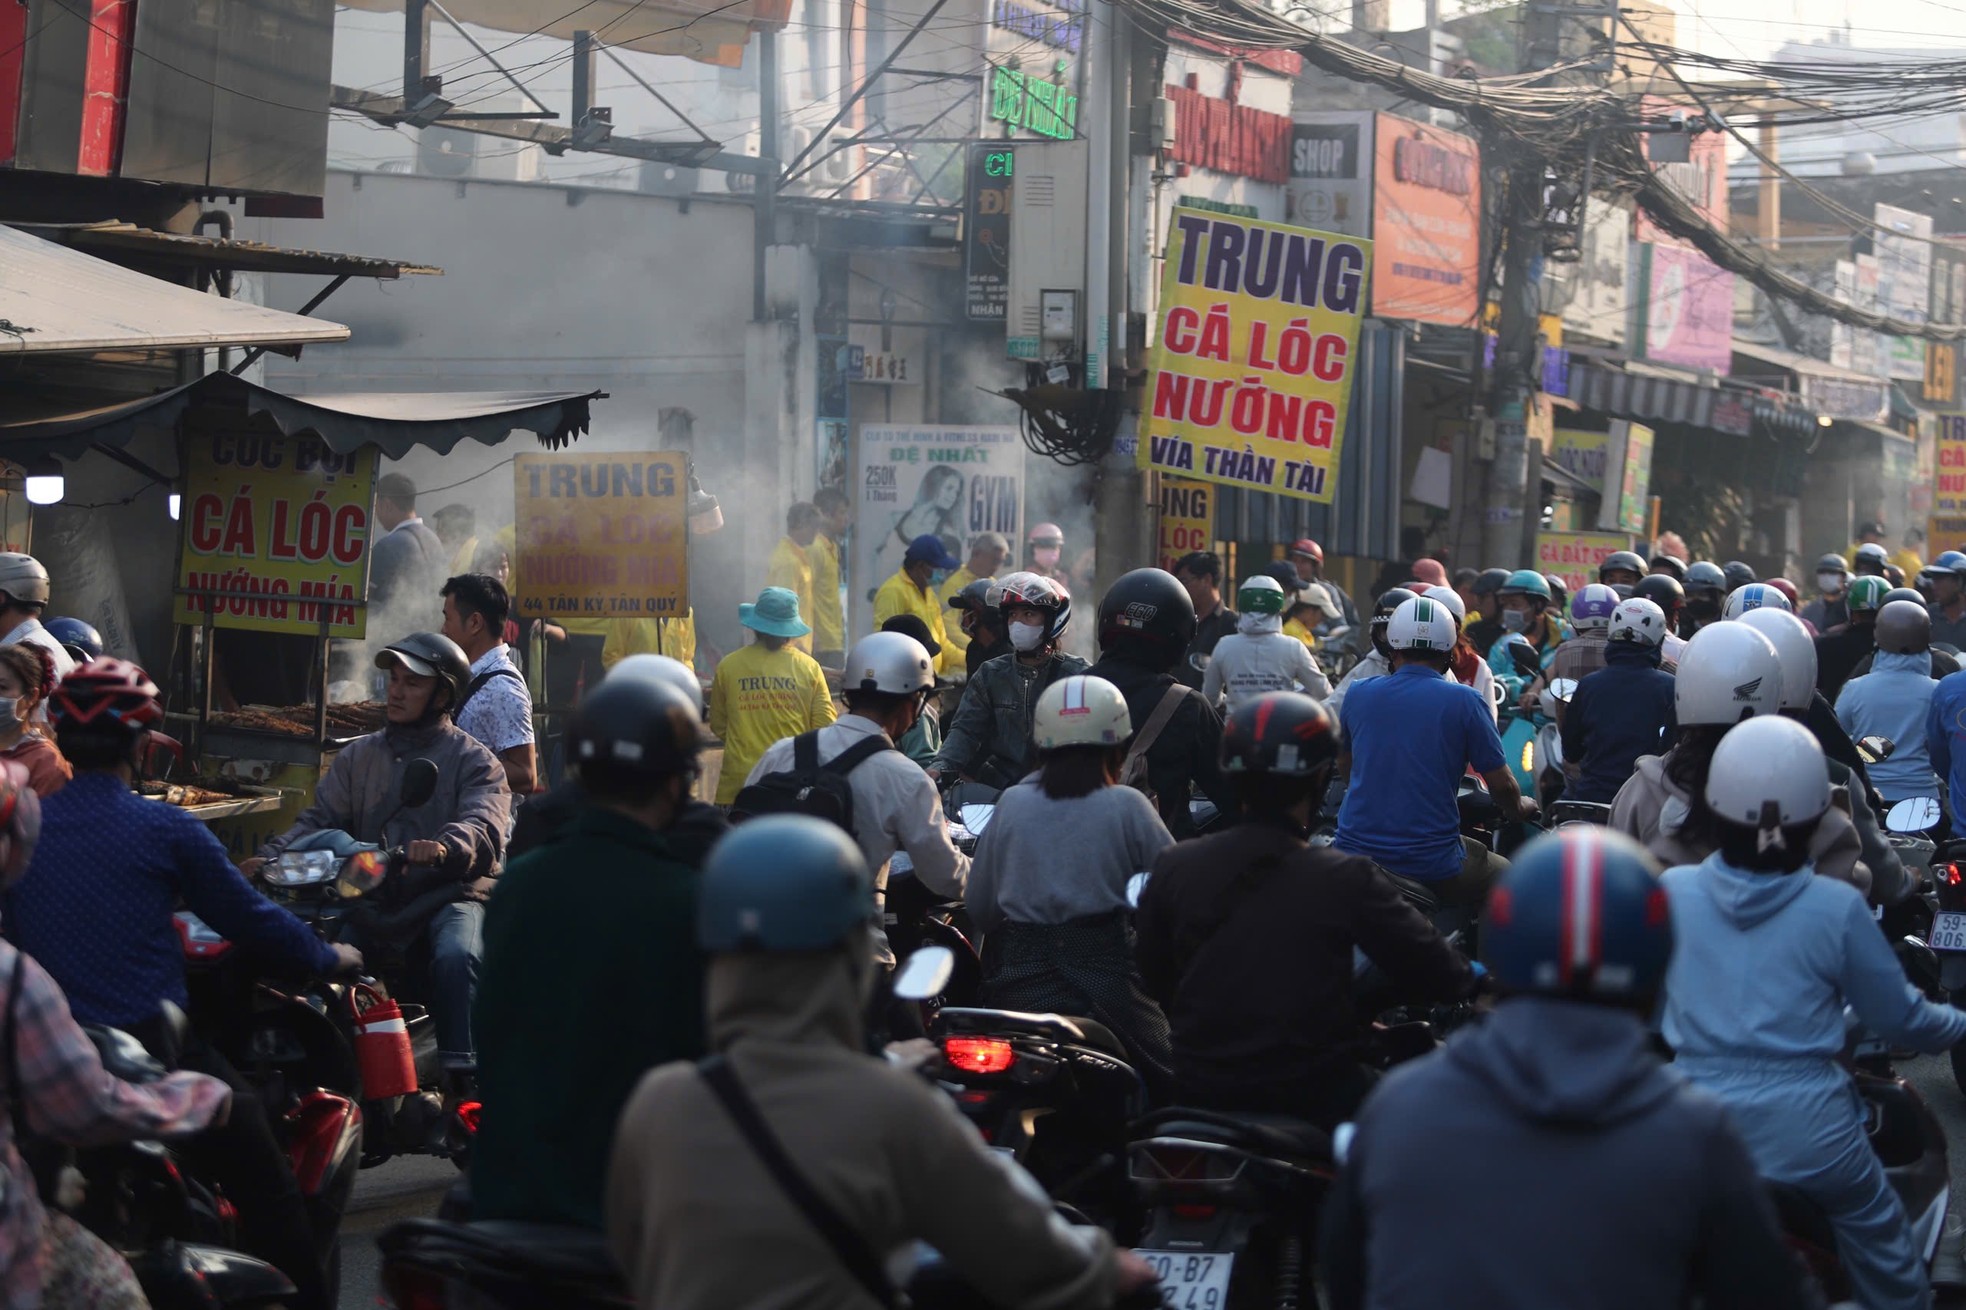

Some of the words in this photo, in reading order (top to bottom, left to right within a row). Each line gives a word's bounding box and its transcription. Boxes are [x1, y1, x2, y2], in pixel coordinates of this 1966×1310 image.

[1294, 138, 1344, 172] SHOP
[1178, 215, 1363, 314] TRUNG
[1164, 304, 1230, 362] CÁ
[1248, 318, 1347, 381] LÓC
[1153, 371, 1336, 449] NƯỚNG
[523, 462, 675, 498] TRUNG
[865, 465, 896, 485] 250K
[1151, 436, 1193, 470] VÍA
[1204, 444, 1275, 485] THẦN
[1285, 460, 1326, 495] TÀI
[191, 484, 255, 555] CÁ
[271, 490, 365, 563] LÓC
[970, 474, 1017, 533] GYM
[602, 504, 673, 545] LÓC
[1161, 522, 1205, 550] LÓC
[526, 550, 618, 586] NƯỚNG
[187, 567, 289, 620] NƯỚNG
[298, 575, 355, 625] MÍA
[524, 599, 543, 611] 44
[549, 592, 578, 611] TÂN
[610, 592, 641, 611] TÂN
[738, 676, 796, 691] TRUNG
